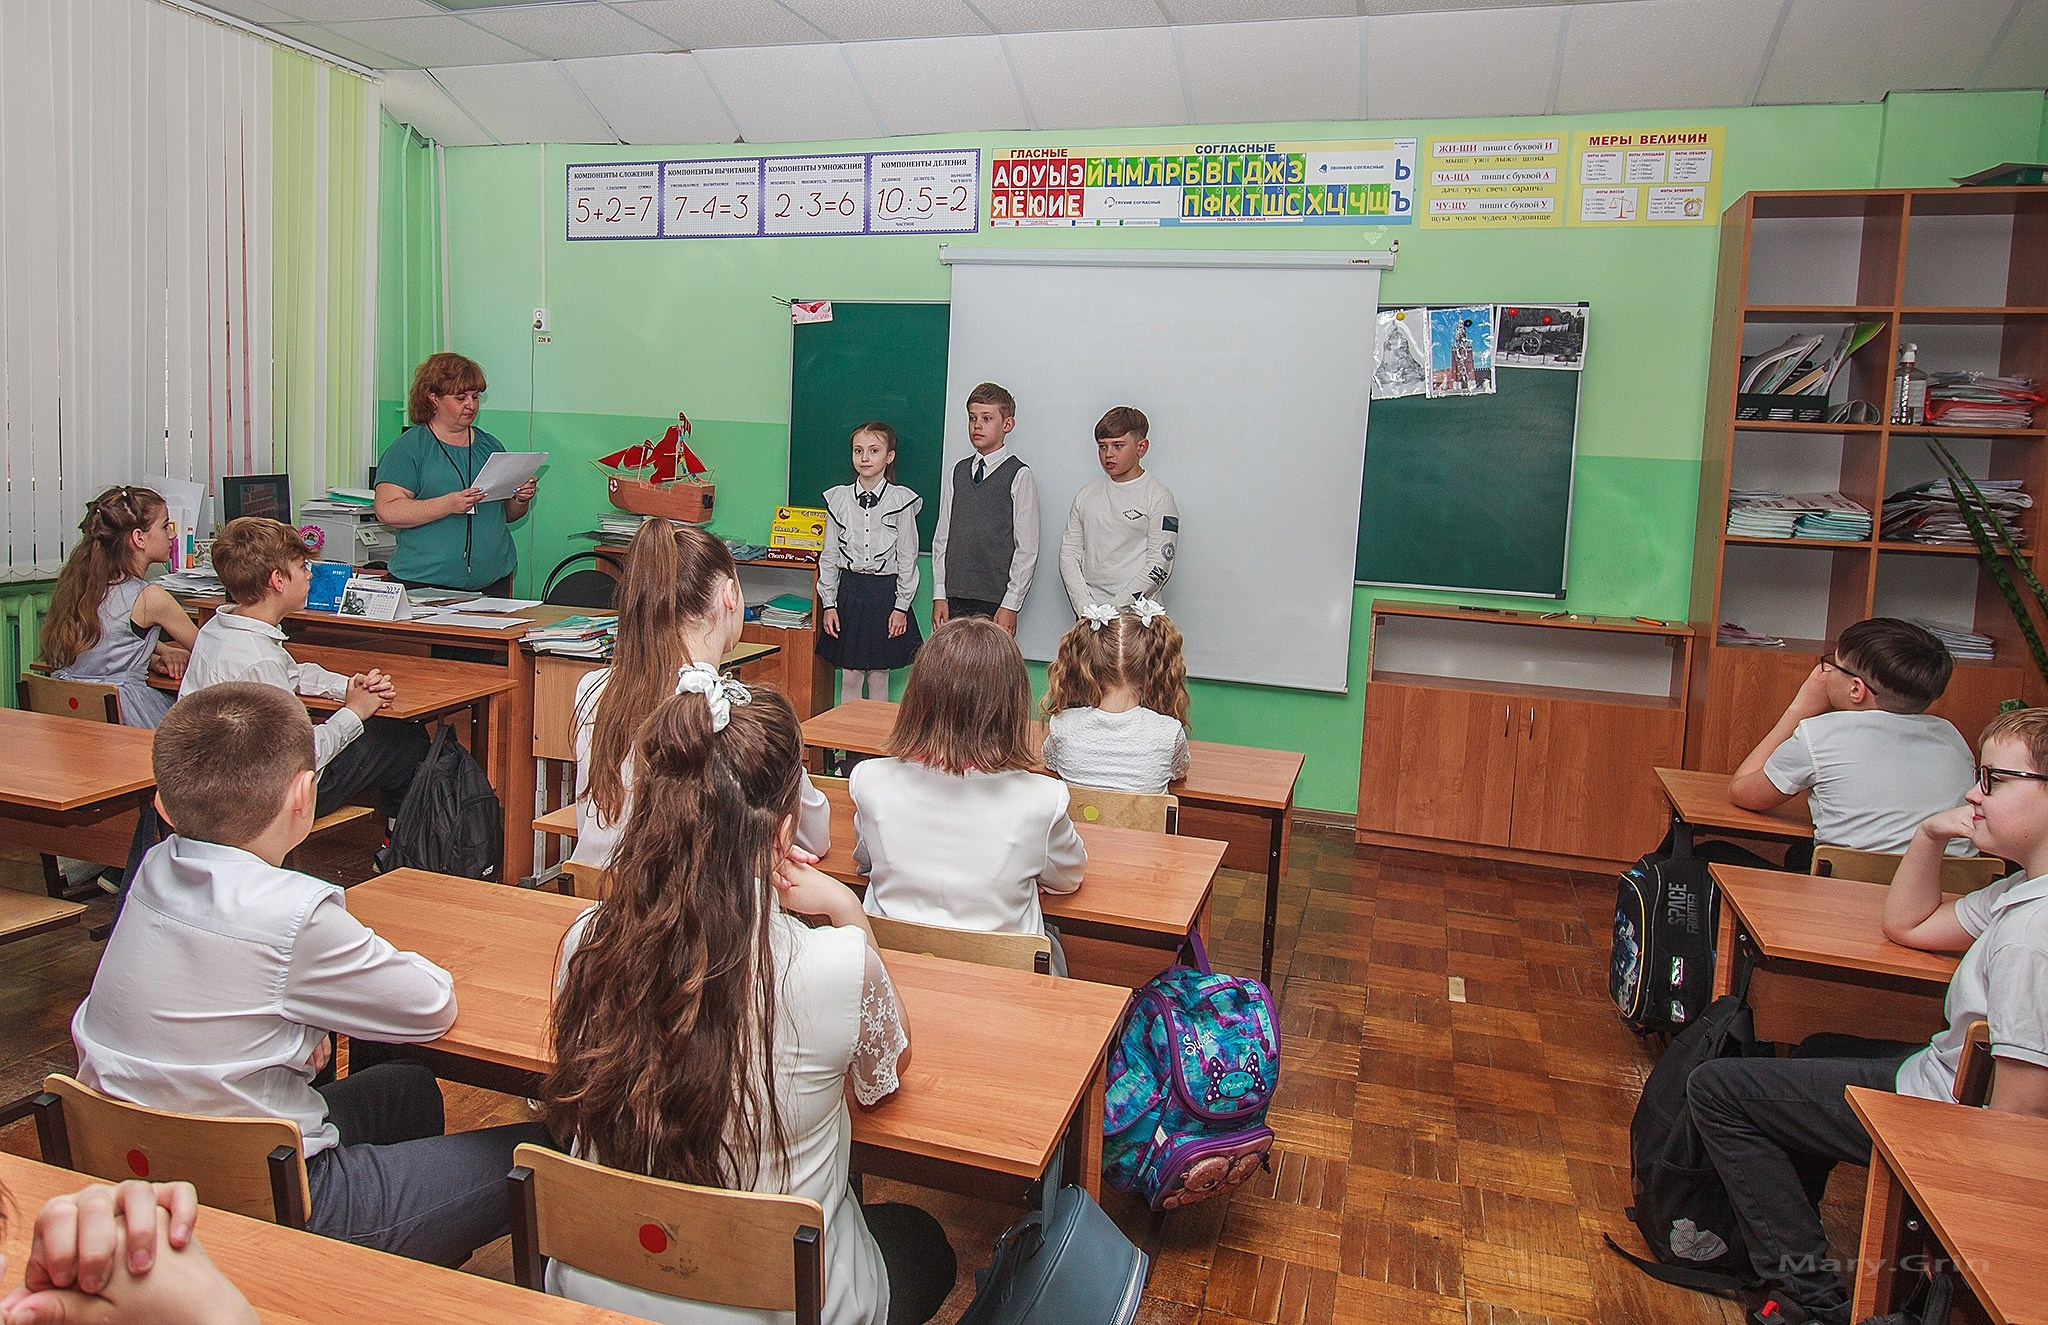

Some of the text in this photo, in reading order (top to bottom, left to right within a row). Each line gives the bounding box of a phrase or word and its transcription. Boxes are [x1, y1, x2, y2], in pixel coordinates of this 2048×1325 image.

[1589, 133, 1707, 145] МЕРЫ ВЕЛИЧИН
[1195, 143, 1276, 154] СОГЛАСНЫЕ
[1438, 144, 1477, 153] ЖИ-ШИ
[1513, 142, 1543, 152] буквой
[1544, 142, 1553, 150] И
[1010, 149, 1068, 158] ГЛАСНЫЕ
[768, 163, 862, 172] КОМПОНЕНТЫ УМНОЖЕНИЯ
[881, 159, 967, 168] КОМПОНЕНТЫ ДЕЛЕНИЯ
[668, 168, 713, 176] КОМПОНЕНТЫ
[1437, 173, 1470, 182] ЧА-ЩА
[1512, 171, 1541, 182] буквой
[1512, 185, 1543, 193] саранча
[1435, 201, 1468, 211] ЧУ-ЩУ
[1510, 200, 1539, 211] буквой
[1541, 200, 1548, 209] У
[1668, 882, 1687, 925] SPACE
[1183, 1029, 1217, 1056] Sweet
